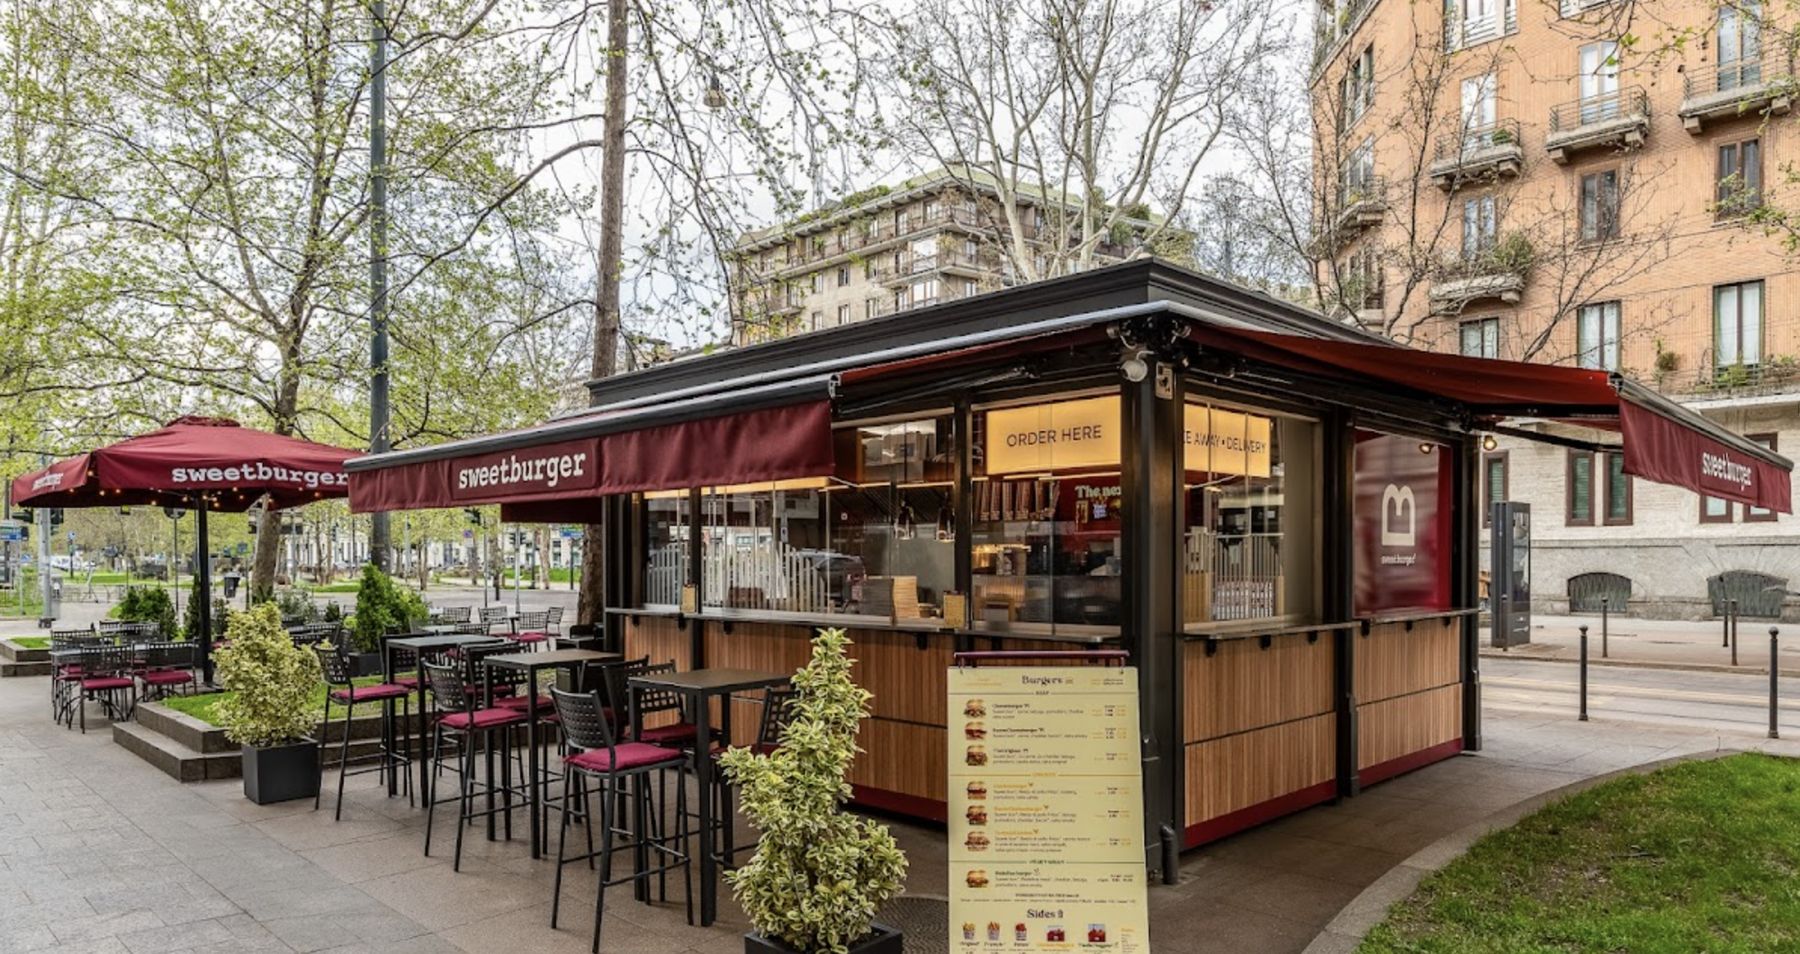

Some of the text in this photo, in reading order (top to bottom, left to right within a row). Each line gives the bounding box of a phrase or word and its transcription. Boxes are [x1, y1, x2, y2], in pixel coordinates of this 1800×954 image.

[1006, 424, 1102, 448] ORDER HERE
[1193, 432, 1220, 447] AWAY
[1226, 436, 1266, 454] DELIVERY
[171, 462, 349, 488] sweetburger
[458, 452, 586, 489] sweetburger
[1702, 451, 1751, 491] sweetburger
[1074, 484, 1100, 499] The
[1021, 675, 1064, 686] Burgers
[1026, 909, 1057, 919] Sides
